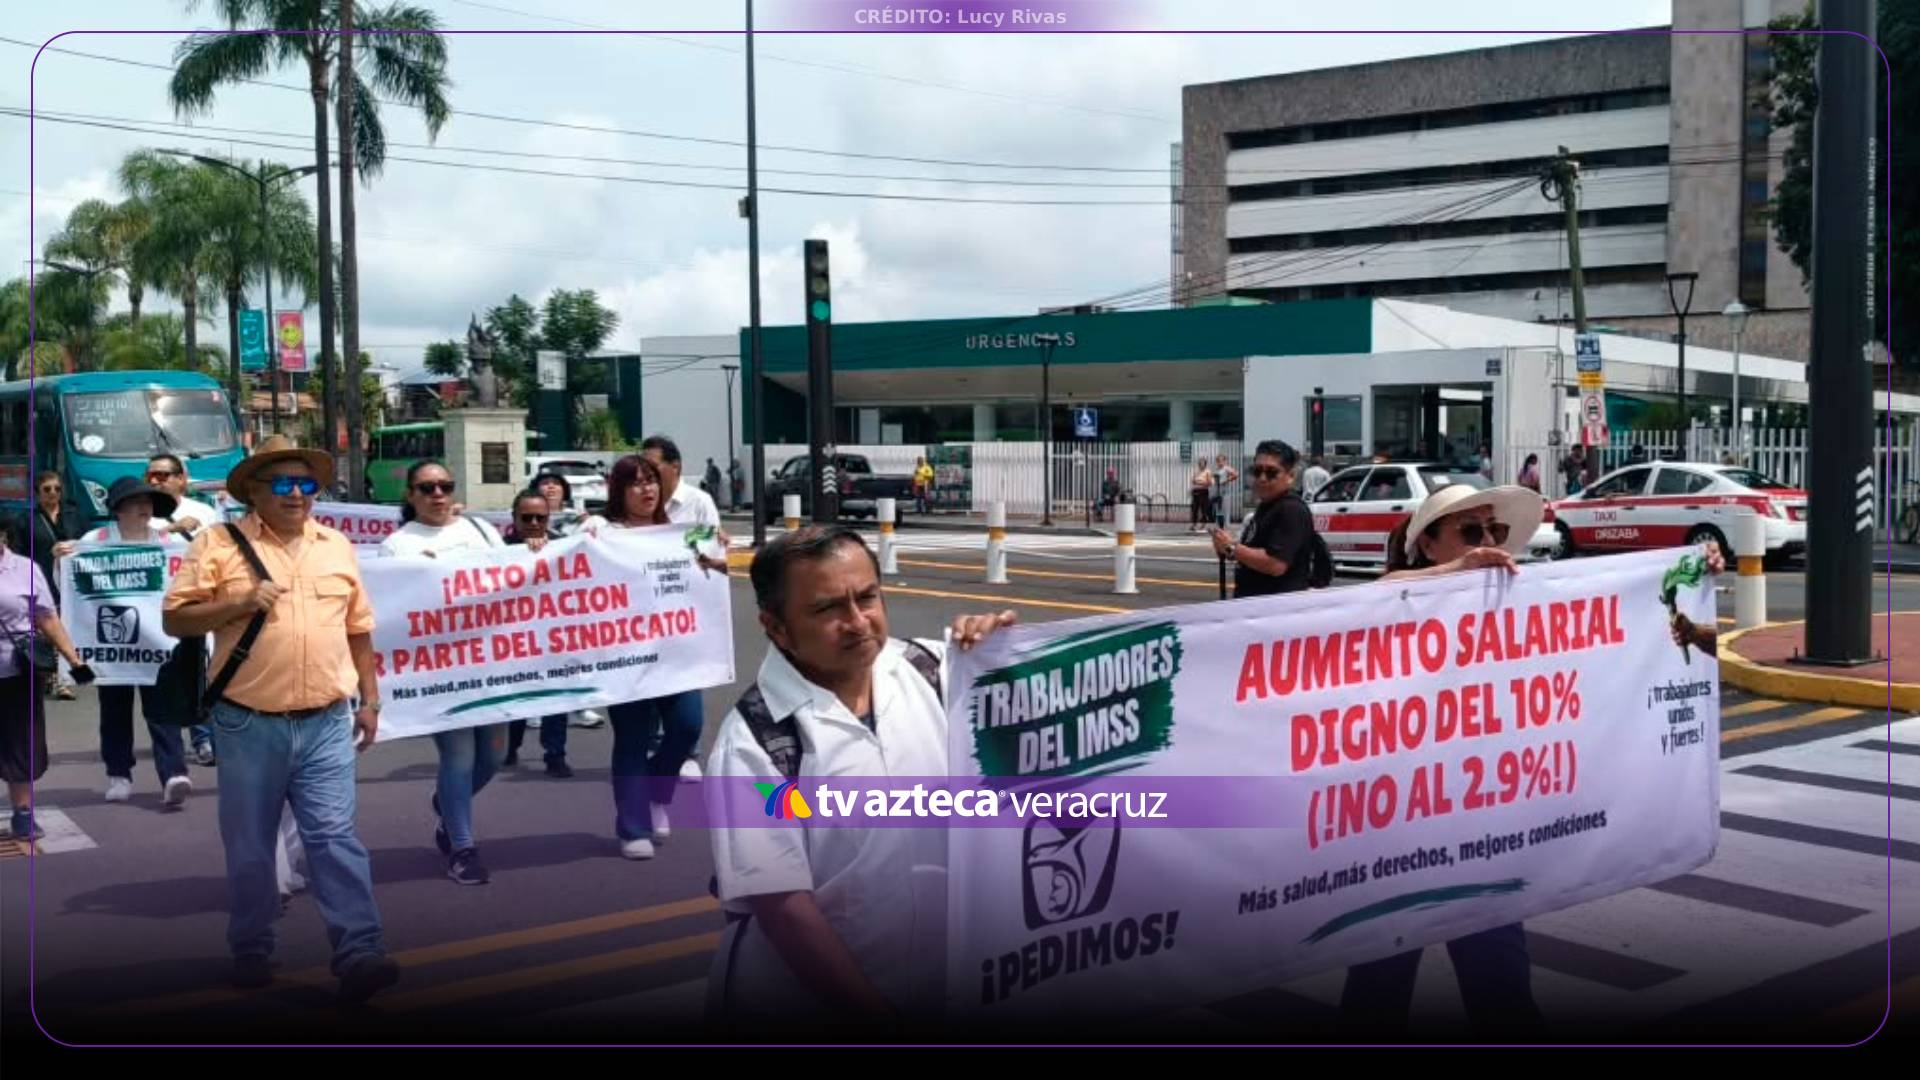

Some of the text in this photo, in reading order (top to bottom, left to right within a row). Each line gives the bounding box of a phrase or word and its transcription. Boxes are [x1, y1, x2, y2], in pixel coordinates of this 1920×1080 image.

[340, 518, 354, 534] A
[359, 519, 394, 536] LOS
[1593, 511, 1617, 522] TAXI
[1595, 528, 1640, 540] ORIZABA
[75, 553, 163, 573] TRABAJADORES
[92, 572, 148, 590] DEL IMSS
[443, 553, 592, 604] ¡ALTO A LA
[392, 638, 486, 675] PARTE
[492, 630, 543, 662] DEL
[549, 606, 697, 655] SINDICATO!
[407, 584, 628, 638] INTIMIDACION
[392, 687, 418, 700] Más
[487, 669, 544, 687] derechos,
[547, 661, 593, 682] mejores
[596, 653, 660, 672] condiciones
[1236, 594, 1625, 702] AUMENTO SALARIAL
[974, 634, 1176, 731] TRABAJADORES
[1018, 697, 1140, 776] DEL IMSS
[1290, 669, 1582, 773] DIGNO DEL 10%
[1405, 764, 1453, 823] AL
[1462, 740, 1577, 812] 2.9%!)
[1238, 890, 1278, 915] Más
[1373, 846, 1454, 881] derechos,
[1459, 826, 1525, 864] mejores
[1528, 809, 1608, 847] condiciones
[980, 909, 1181, 1004] ¡PEDIMOS!
